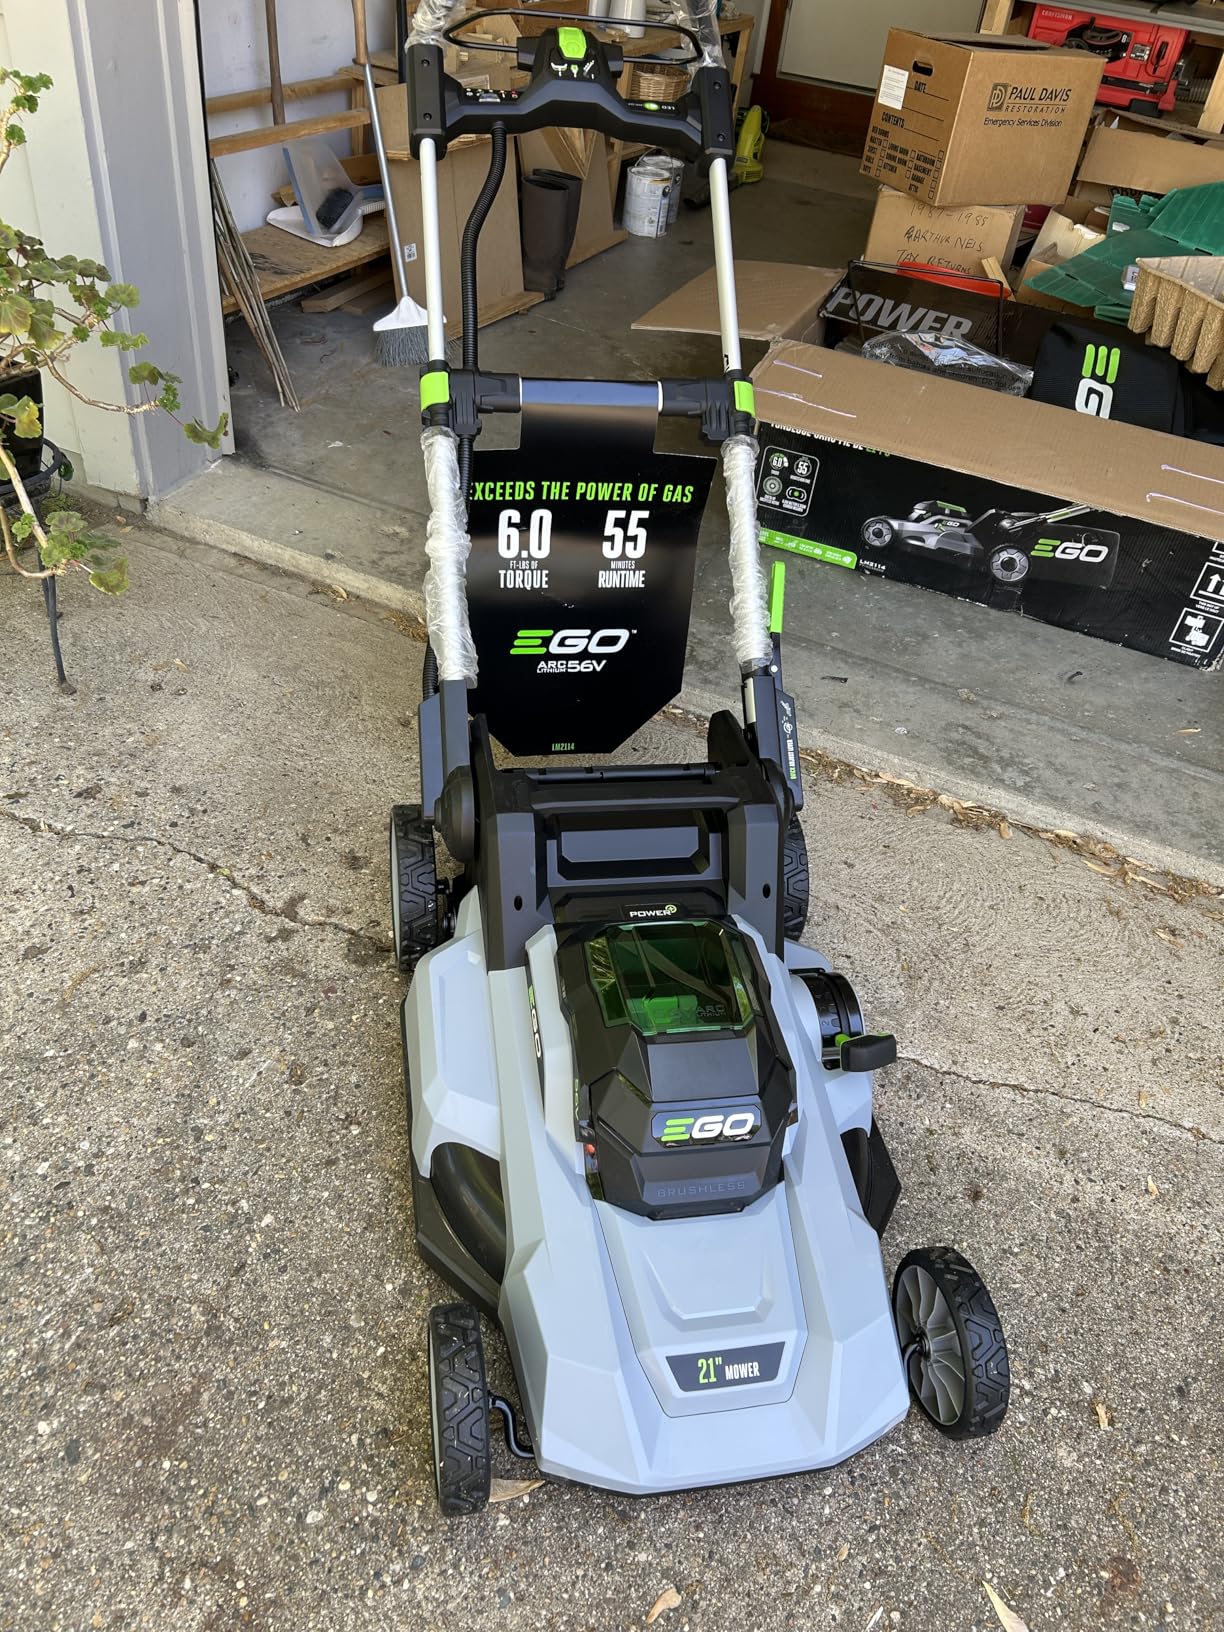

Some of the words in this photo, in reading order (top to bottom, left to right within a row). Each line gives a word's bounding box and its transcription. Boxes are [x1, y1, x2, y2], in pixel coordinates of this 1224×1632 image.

[913, 80, 927, 94] DATE
[1008, 86, 1037, 101] PAUL
[1038, 87, 1072, 102] DAVIS
[1004, 105, 1066, 114] RESTORATION
[881, 111, 905, 129] CONTENTS
[984, 117, 1016, 127] Emergency
[1016, 118, 1040, 127] Services
[1040, 118, 1063, 127] Division
[825, 286, 973, 339] POWER
[797, 461, 808, 475] 55
[541, 481, 570, 500] THE
[575, 482, 632, 501] POWER
[637, 483, 658, 501] OF
[662, 484, 694, 503] GAS
[498, 509, 552, 559] 6.0
[602, 510, 650, 559] 55
[1030, 538, 1109, 563] EGO
[510, 560, 529, 569] FT-LBS
[531, 560, 538, 569] OF
[611, 560, 635, 569] MINUTES
[499, 570, 549, 590] TORQUE
[598, 570, 645, 588] RUNTIME
[510, 629, 630, 655] EGO
[538, 660, 567, 669] ARC
[567, 660, 607, 672] 56V
[661, 1112, 755, 1142] EGO
[657, 1181, 745, 1198] BRUSHLESS
[697, 1356, 723, 1384] 21"
[724, 1361, 760, 1380] MOWER
